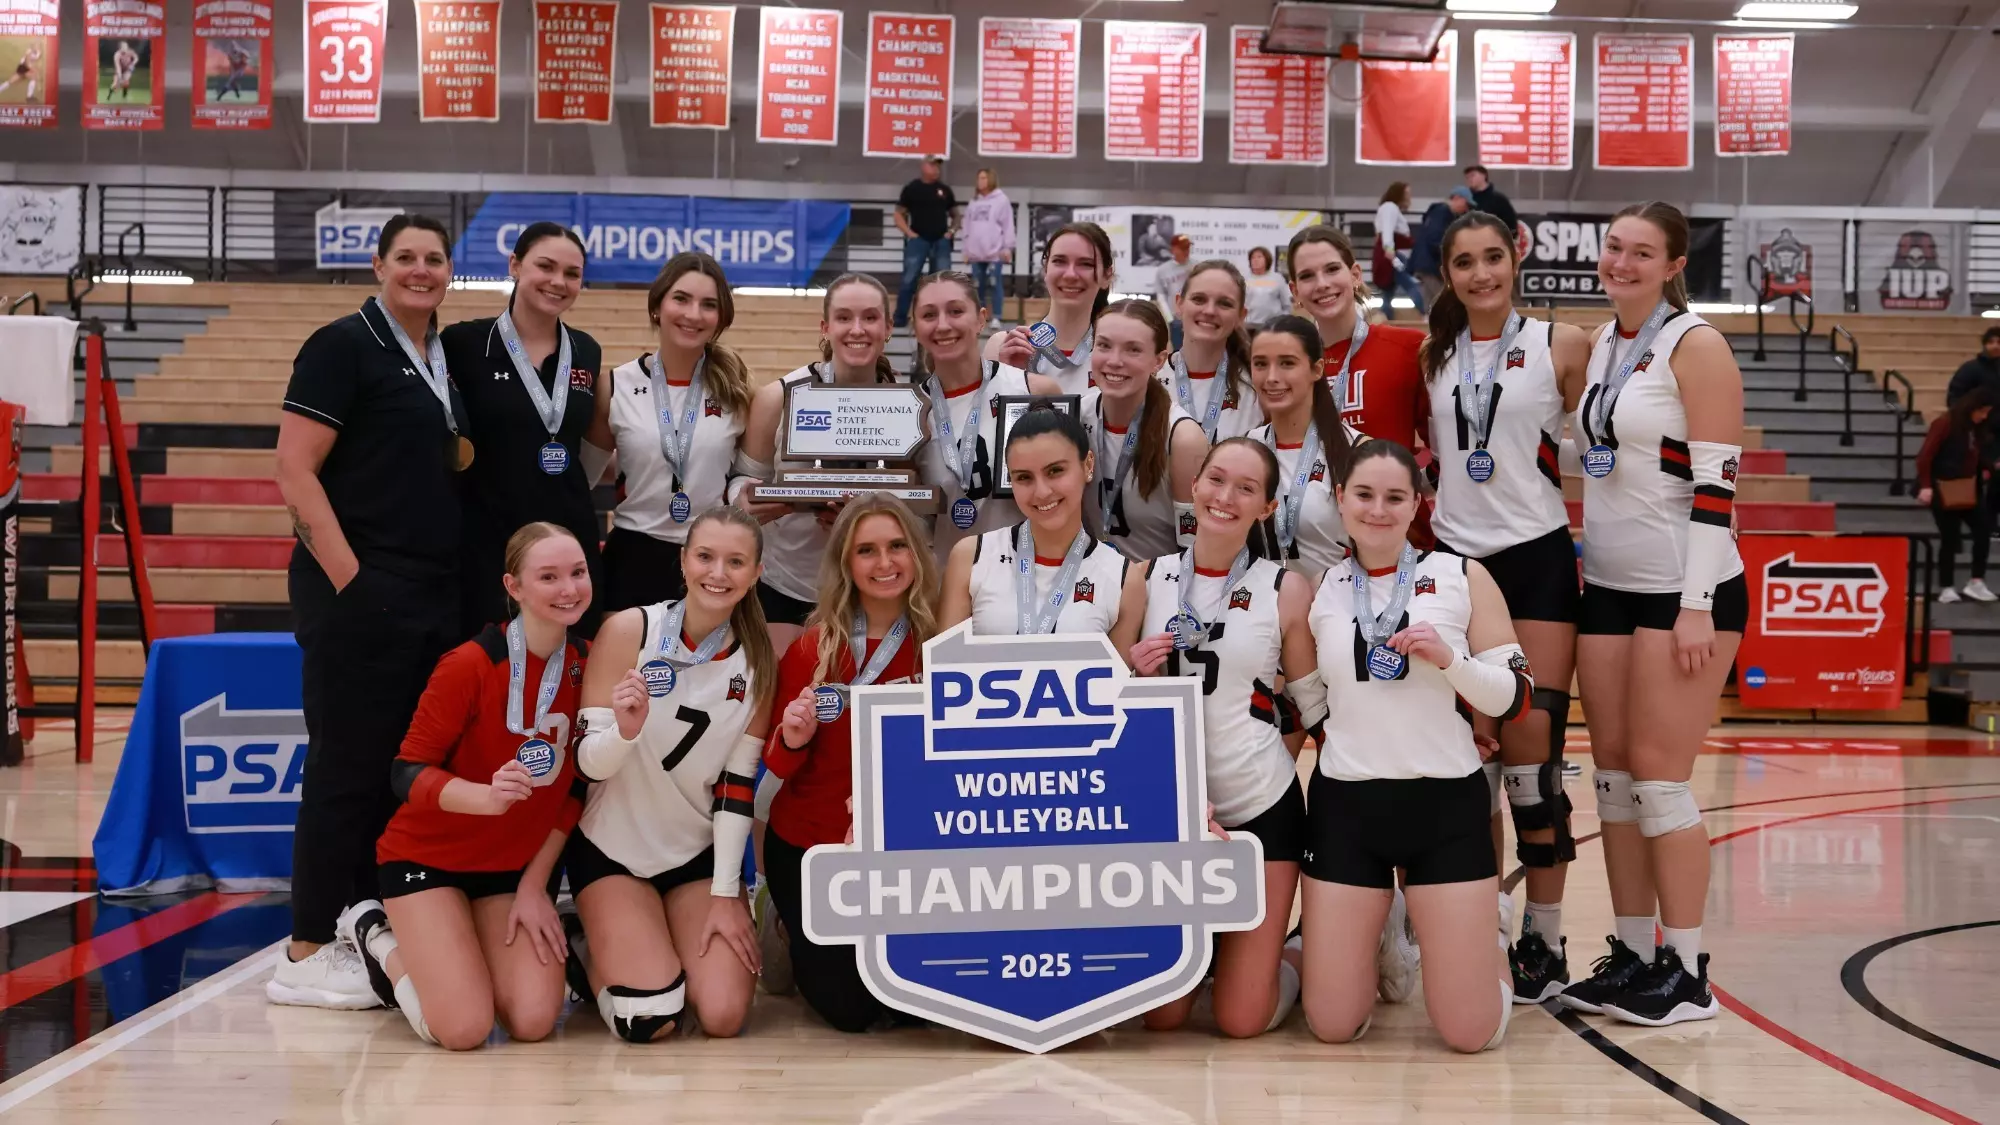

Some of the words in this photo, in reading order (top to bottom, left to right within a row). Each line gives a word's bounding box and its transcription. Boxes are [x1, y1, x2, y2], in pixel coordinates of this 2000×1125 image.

[428, 21, 490, 33] CHAMPIONS
[538, 19, 587, 31] EASTERN
[545, 33, 605, 46] CHAMPIONS
[660, 27, 722, 41] CHAMPIONS
[769, 33, 831, 47] CHAMPIONS
[878, 40, 943, 54] CHAMPIONS
[320, 35, 373, 83] 33
[430, 50, 488, 60] BASKETBALL
[785, 49, 814, 60] MEN'S
[546, 60, 603, 71] BASKETBALL
[662, 56, 719, 68] BASKETBALL
[895, 56, 924, 68] MEN'S
[769, 63, 828, 75] BASKETBALL
[878, 72, 940, 84] BASKETBALL
[768, 93, 827, 104] TOURNAMENT
[871, 87, 896, 98] NCAA
[899, 89, 944, 101] REGIONAL
[883, 103, 932, 116] FINALISTS
[320, 226, 382, 250] PSA
[496, 223, 794, 263] CMPIONSHIPS
[1889, 268, 1950, 298] IUP
[837, 405, 913, 414] PENNSYLVANIA
[796, 415, 832, 426] PSAC
[836, 416, 867, 424] STATE
[836, 427, 885, 435] ATHLETIC
[835, 438, 901, 447] CONFERENCE
[673, 501, 688, 509] PSAC
[1767, 583, 1879, 613] PSAC
[5, 514, 19, 735] WARRIORS
[1373, 651, 1399, 667] PSAC
[644, 671, 671, 680] PSAC
[1818, 672, 1845, 681] MAKE
[931, 667, 1115, 721] PSAC
[662, 704, 711, 771] 7
[521, 749, 549, 761] PSAC
[184, 743, 309, 796] PSA
[527, 763, 551, 771] HAMPIONS
[955, 769, 1106, 798] WOMEN'S
[934, 805, 1128, 835] VOLLEYBALL
[828, 858, 1238, 917] CHAMPIONS
[1001, 952, 1072, 979] 2025
